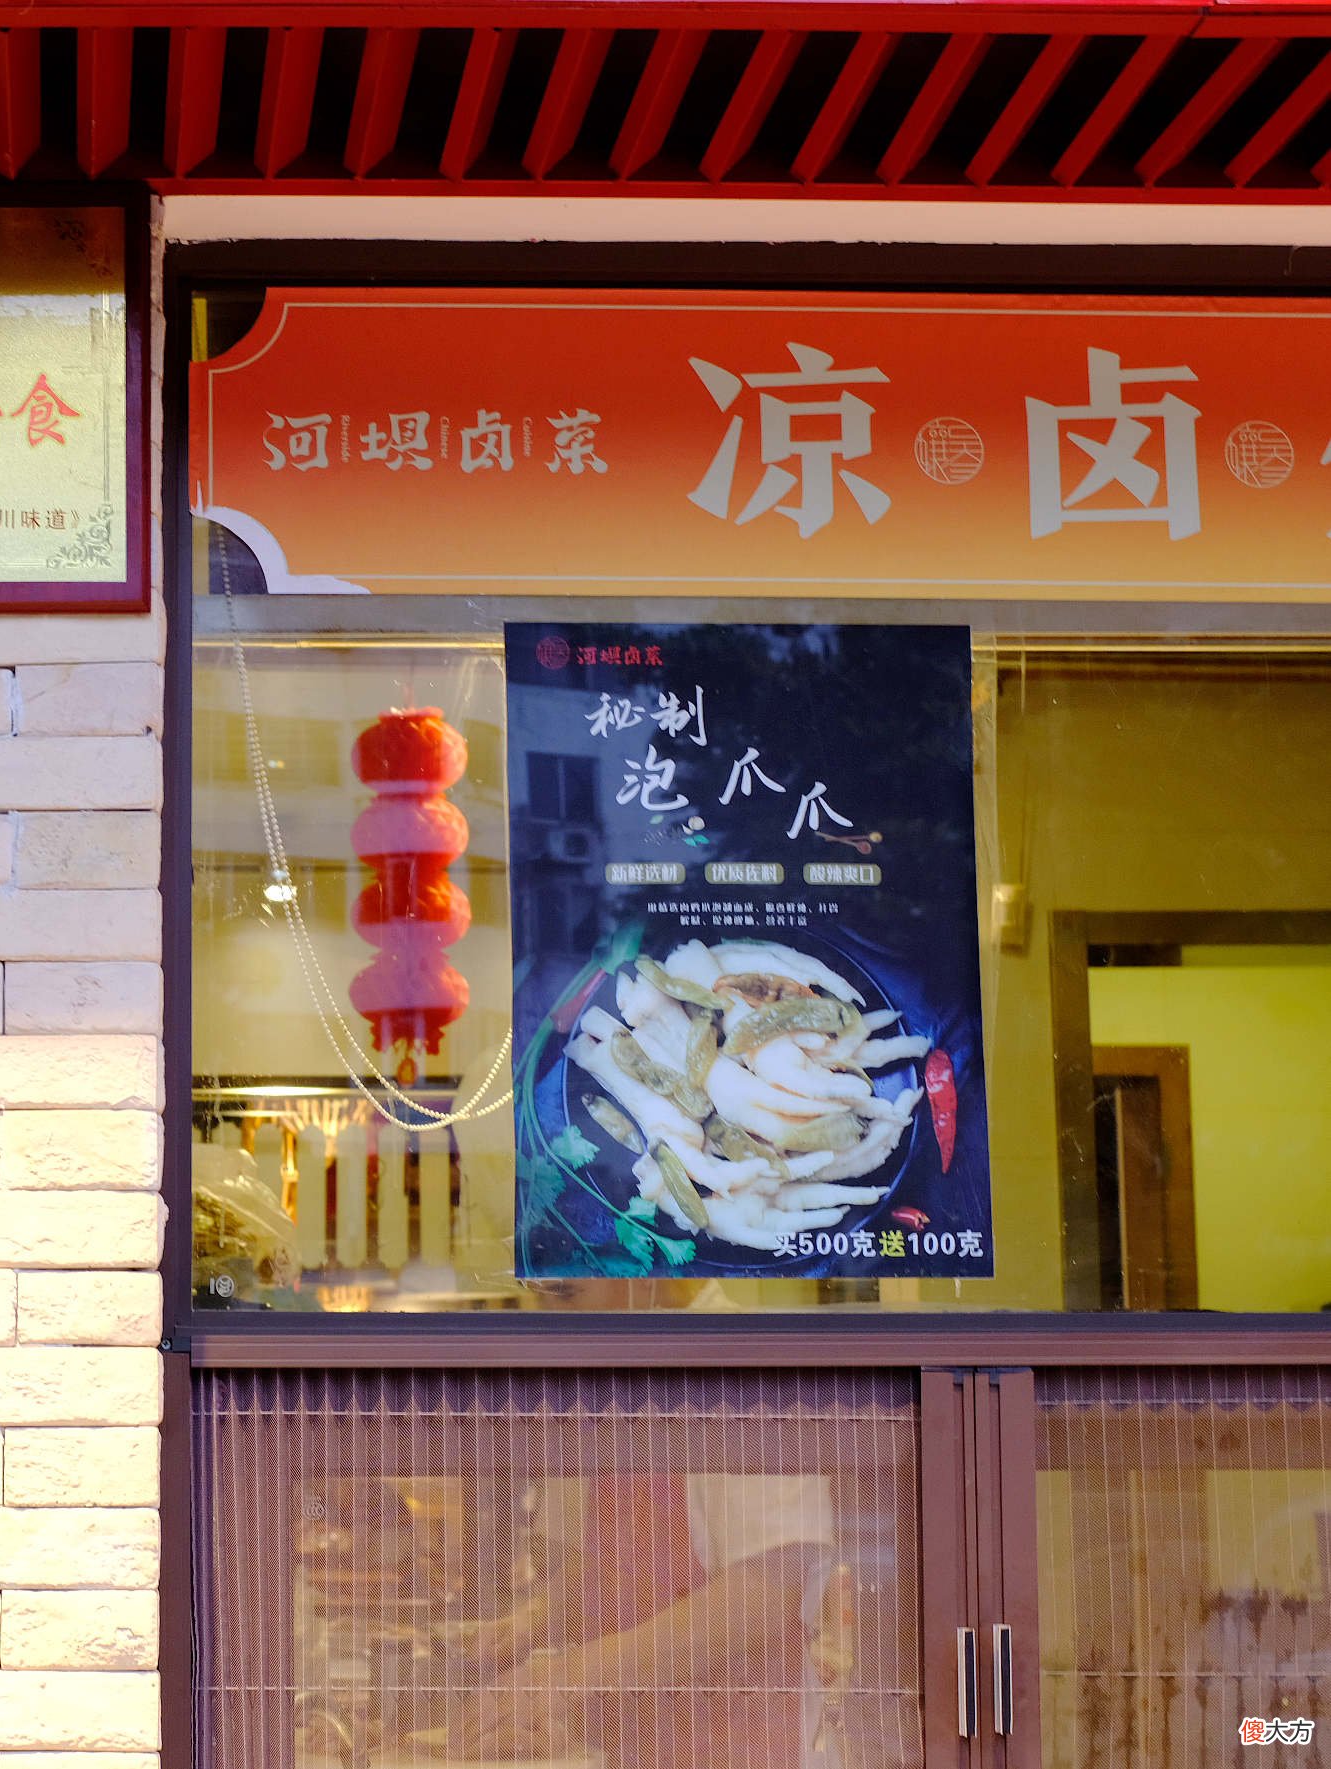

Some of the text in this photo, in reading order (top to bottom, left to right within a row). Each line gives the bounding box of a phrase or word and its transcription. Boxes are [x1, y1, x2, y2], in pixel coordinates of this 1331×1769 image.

[584, 685, 709, 747] 秘制
[809, 865, 875, 884] 酸辣爽口
[773, 1229, 984, 1259] 买500克送100克
